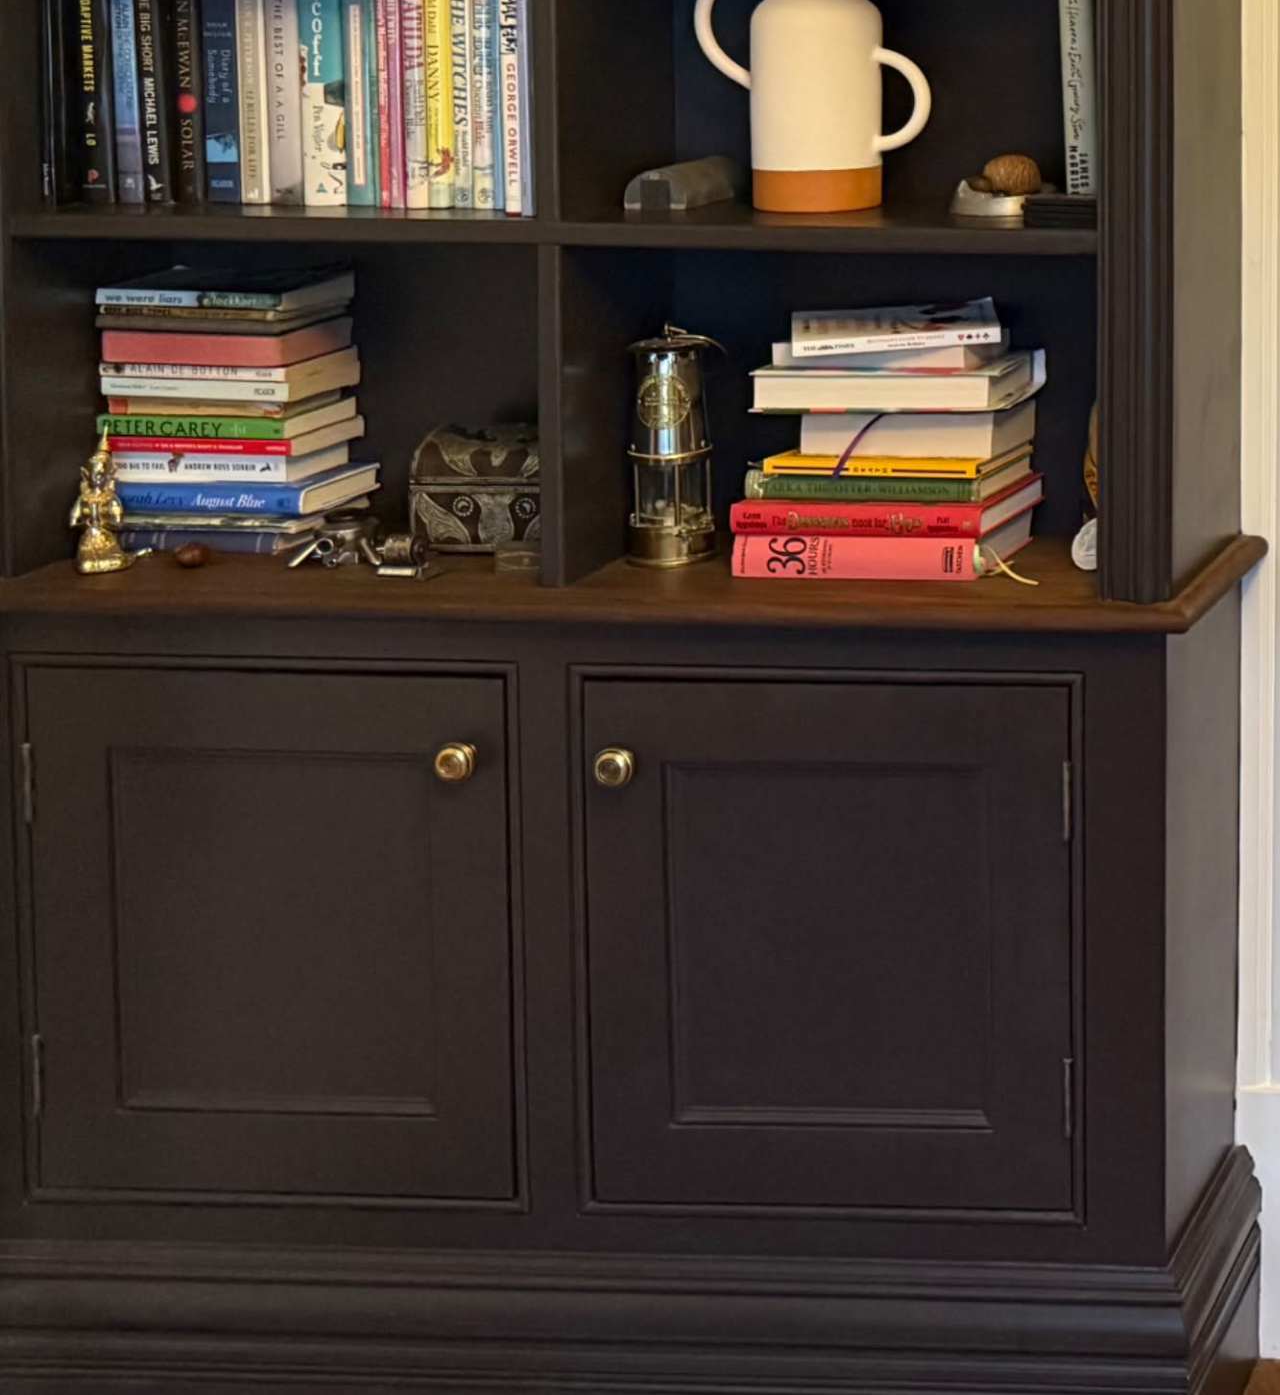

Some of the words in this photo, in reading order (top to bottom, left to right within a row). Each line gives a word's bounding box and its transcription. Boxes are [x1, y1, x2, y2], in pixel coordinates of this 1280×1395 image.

[139, 12, 151, 32] BIG
[140, 35, 153, 72] SHORT
[273, 27, 283, 56] BEST
[82, 45, 94, 92] MARKETS
[274, 63, 284, 80] OF
[427, 44, 439, 102] DANNY
[453, 33, 468, 127] WITCHES
[143, 77, 157, 127] MICHAEL
[275, 86, 284, 94] A
[506, 63, 517, 122] GEORGE
[86, 134, 96, 146] LO
[180, 118, 194, 170] SOLAR
[276, 115, 286, 140] GILL
[147, 130, 159, 165] LEWIS
[507, 128, 518, 187] ORWELL
[160, 420, 223, 437] CAREY
[192, 491, 234, 510] August
[237, 492, 266, 508] Blue
[767, 536, 808, 575] 36
[808, 536, 819, 575] HOURS
